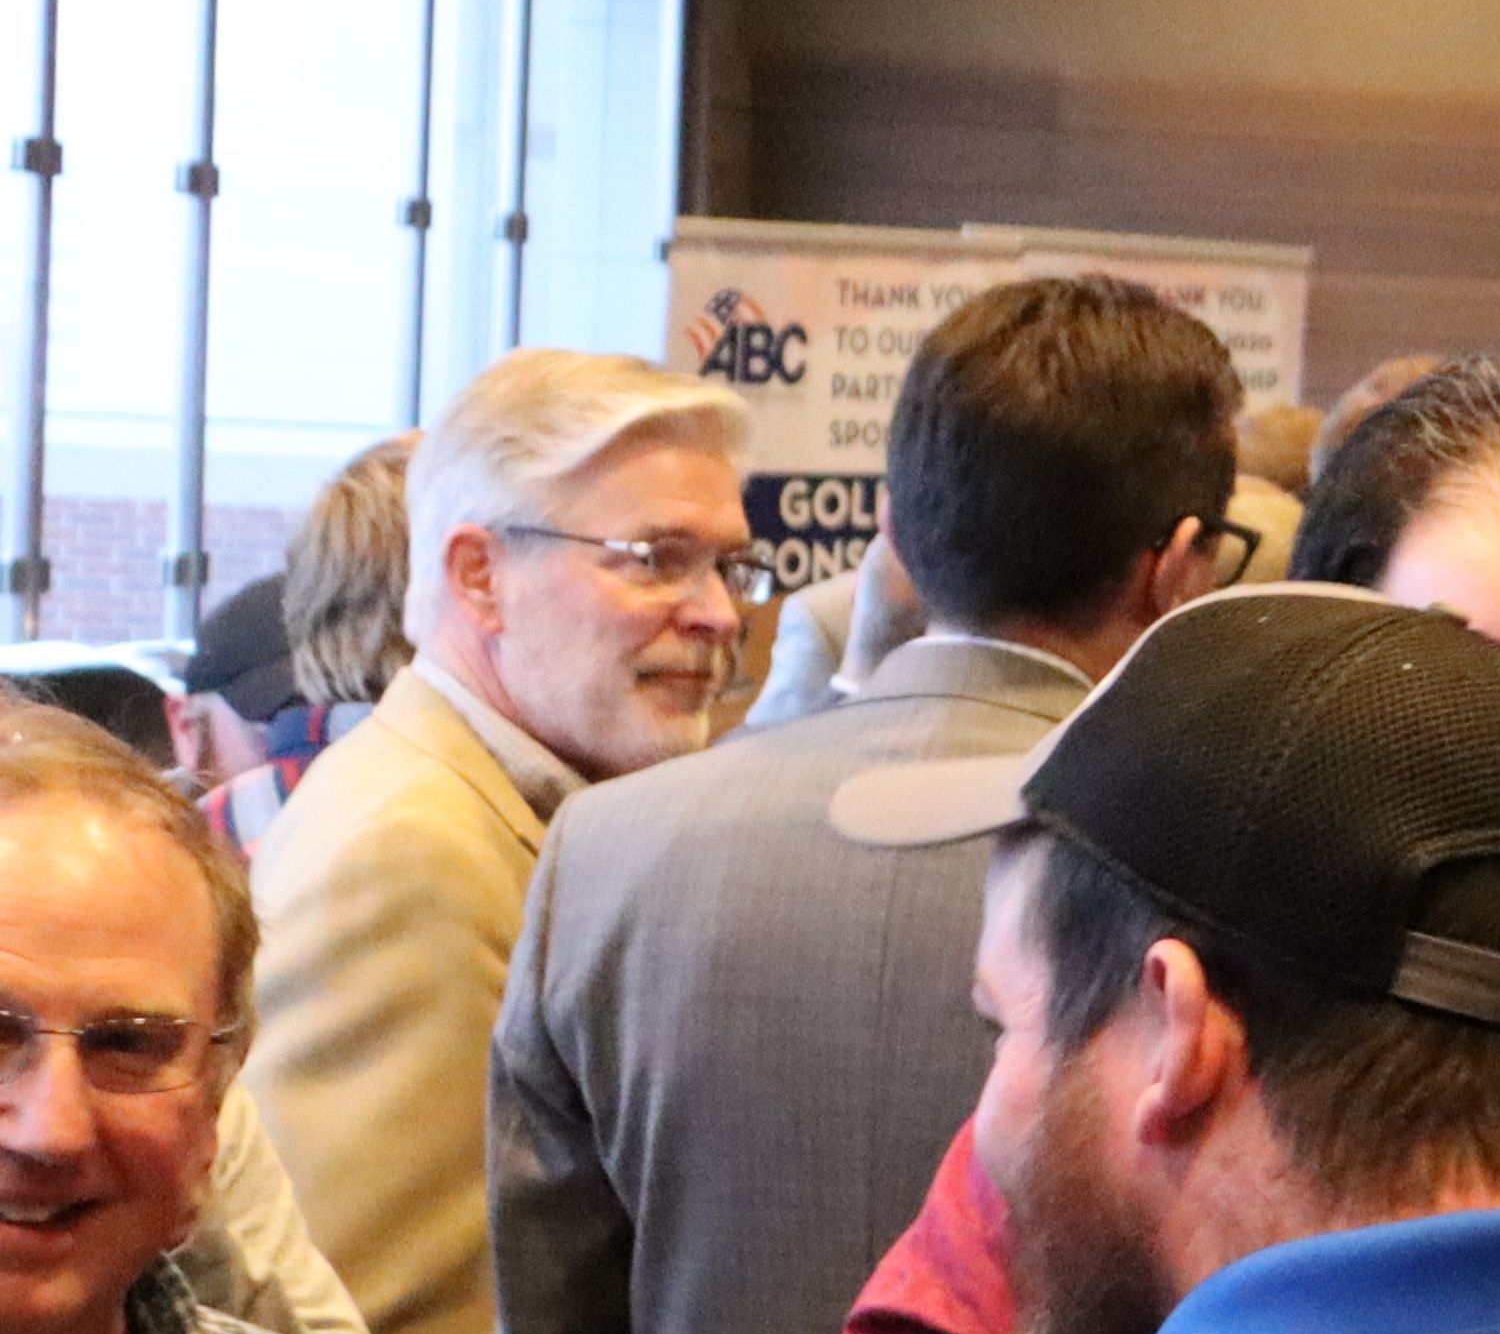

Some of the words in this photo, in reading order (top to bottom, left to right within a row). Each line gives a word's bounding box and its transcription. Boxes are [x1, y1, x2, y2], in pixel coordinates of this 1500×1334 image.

[838, 279, 920, 308] THANK
[1218, 287, 1265, 311] YOU
[699, 322, 808, 385] ABC
[835, 326, 869, 353] TO
[831, 372, 897, 400] PART
[829, 420, 891, 448] SPO
